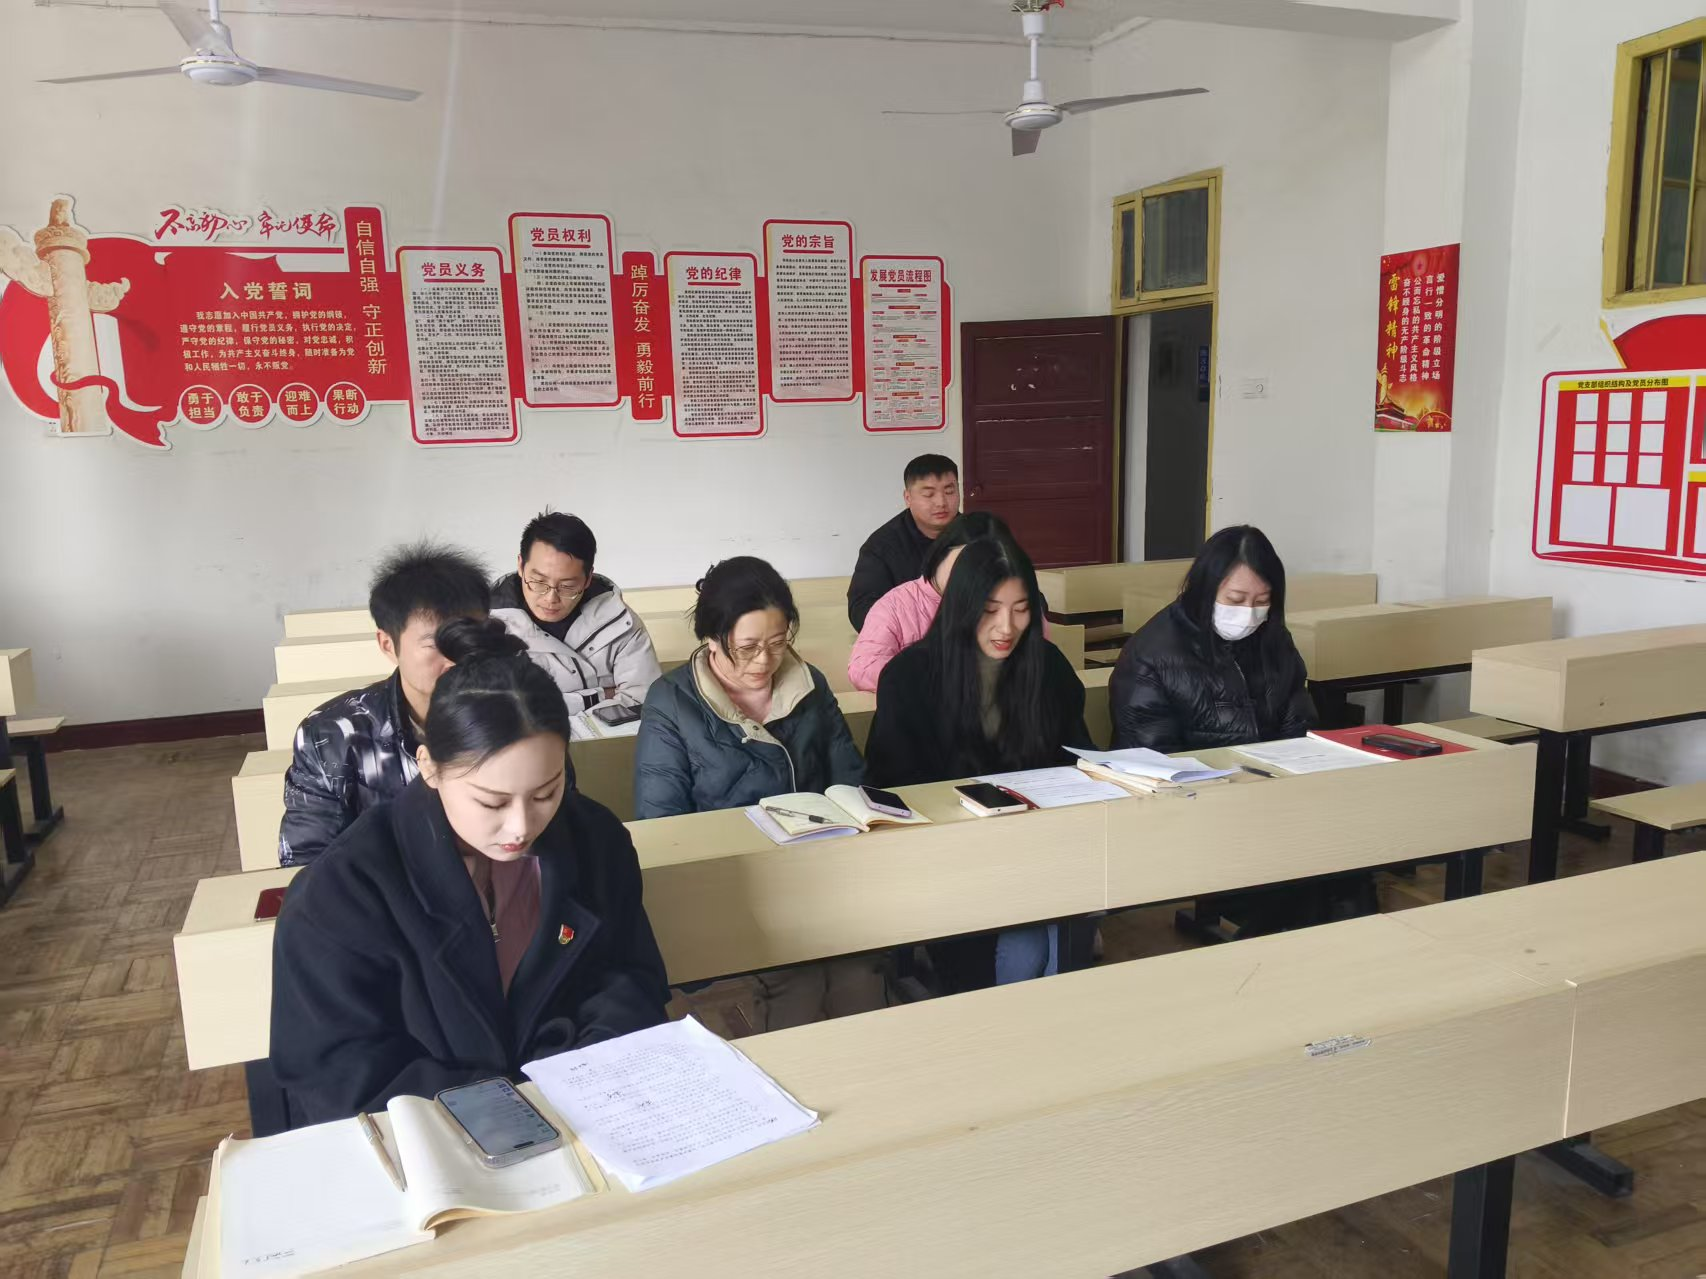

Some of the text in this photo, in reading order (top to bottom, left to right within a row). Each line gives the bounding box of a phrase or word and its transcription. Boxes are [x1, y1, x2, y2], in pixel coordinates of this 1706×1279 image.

[530, 227, 592, 243] 党员权利
[781, 233, 835, 249] 党的宗旨
[421, 262, 485, 278] 党员义务
[685, 266, 742, 281] 党的纪律
[870, 268, 932, 283] 发展党员流程图
[220, 282, 312, 300] 入党誓词
[356, 220, 388, 374] 自信自强 守正创新
[1385, 273, 1401, 361] 雷锋精神
[1399, 277, 1411, 383] 奋不顾身的无产阶级斗志
[1409, 276, 1422, 383] 公而忘私的共产主义风格
[1421, 274, 1434, 381] 言行一致的革命精神
[1431, 272, 1446, 381] 爱憎分明的阶级立场
[630, 264, 656, 409] 踔厉奋发 勇毅前行
[1577, 377, 1669, 389] 党支部组织结构及党员分布图
[187, 392, 214, 405] 勇于
[236, 391, 263, 404] 敢于
[284, 390, 311, 403] 迎难
[332, 389, 358, 402] 果断
[189, 406, 216, 419] 担当
[238, 405, 265, 418] 负责
[286, 404, 313, 416] 而上
[333, 402, 360, 415] 行动
